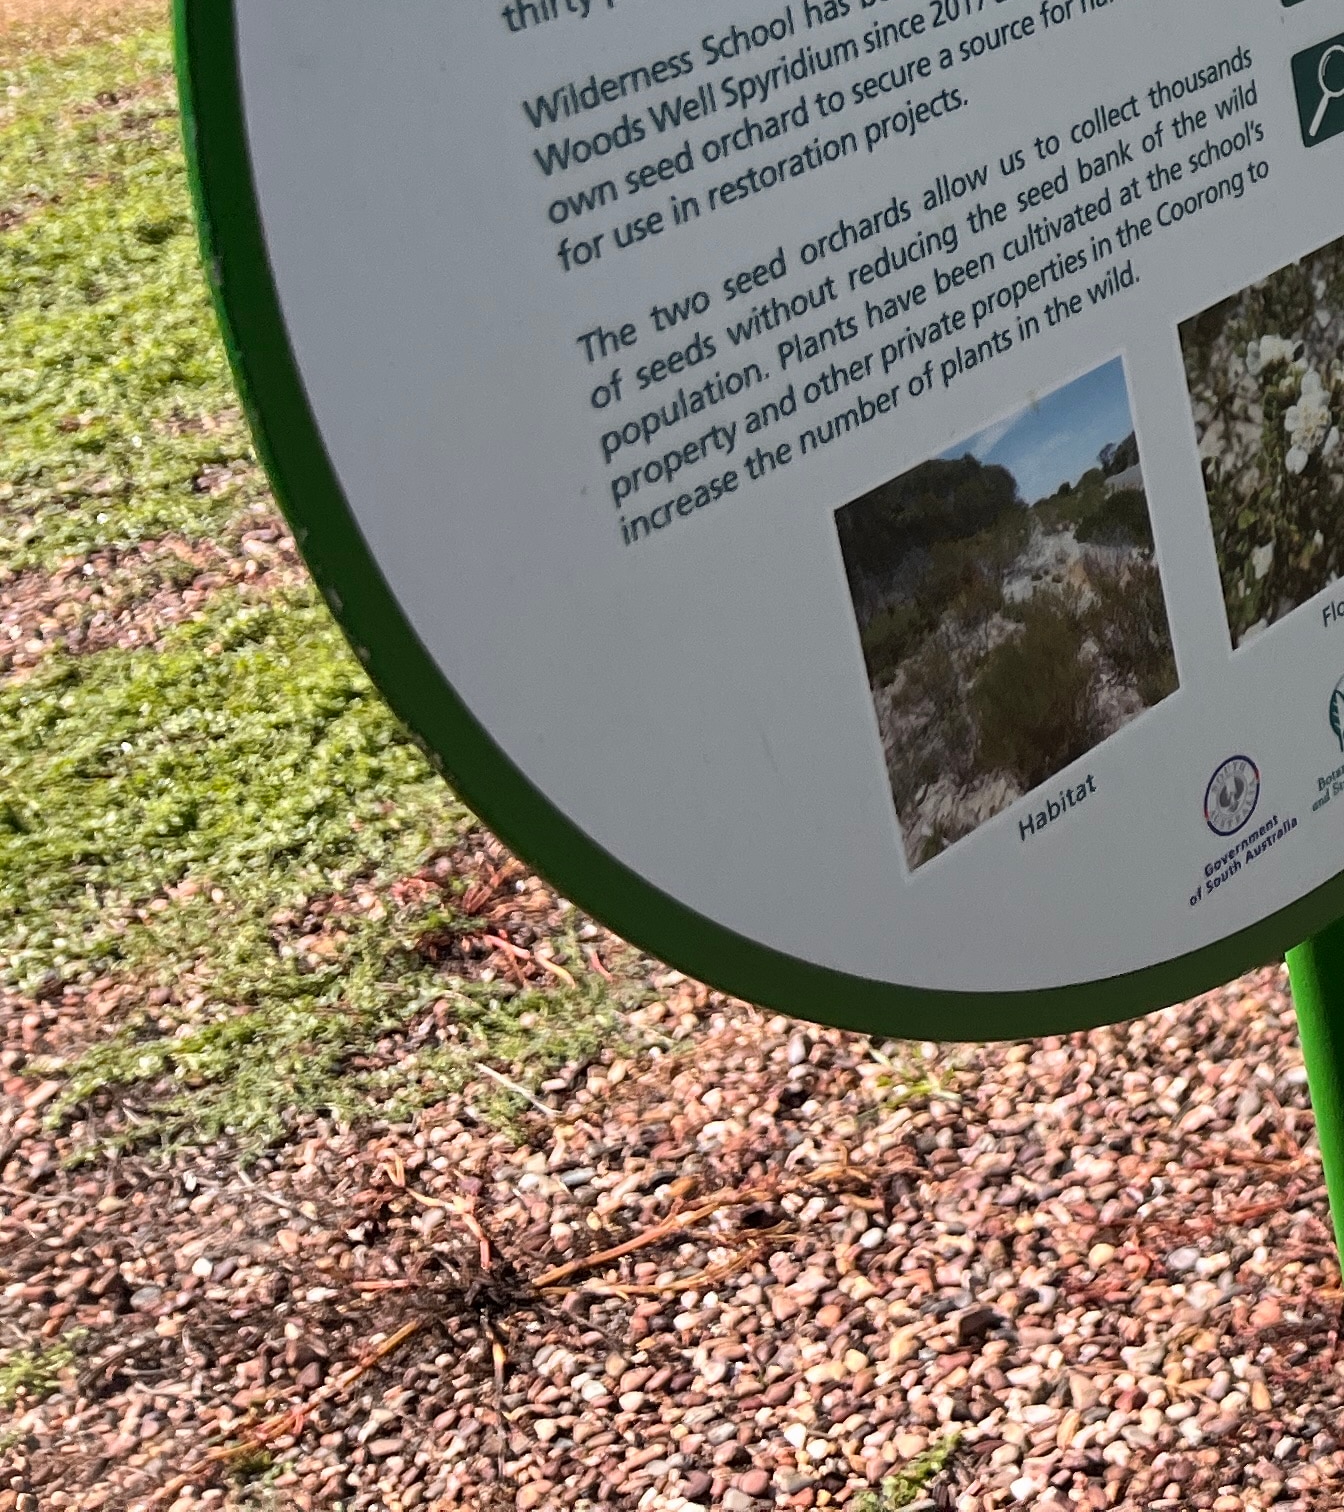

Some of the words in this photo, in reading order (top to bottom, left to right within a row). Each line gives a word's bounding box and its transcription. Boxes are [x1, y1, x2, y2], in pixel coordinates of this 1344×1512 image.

[522, 50, 694, 129] Wilderness
[701, 5, 795, 66] School
[556, 233, 605, 272] for
[612, 211, 664, 249] use
[670, 195, 701, 226] in
[707, 132, 858, 211] restoration
[864, 88, 969, 153] projects.
[576, 323, 638, 363] The
[649, 291, 711, 332] two
[723, 246, 787, 302] seed
[800, 196, 912, 265] orchards
[923, 165, 988, 211] allow
[999, 149, 1026, 177] us
[1033, 134, 1060, 160] to
[1070, 95, 1141, 144] collect
[1147, 45, 1253, 110] thousands
[600, 363, 770, 465] population.
[777, 316, 859, 371] Plants
[864, 284, 927, 329] have
[933, 252, 995, 296] been
[1002, 186, 1112, 262] cultivated
[1119, 177, 1142, 207] at
[1145, 162, 1183, 192] the
[1188, 120, 1264, 174] school's
[1018, 774, 1097, 841] Habitat
[1189, 886, 1202, 907] of
[1205, 859, 1242, 895] South
[1245, 817, 1298, 864] Australia
[1204, 814, 1279, 878] Government
